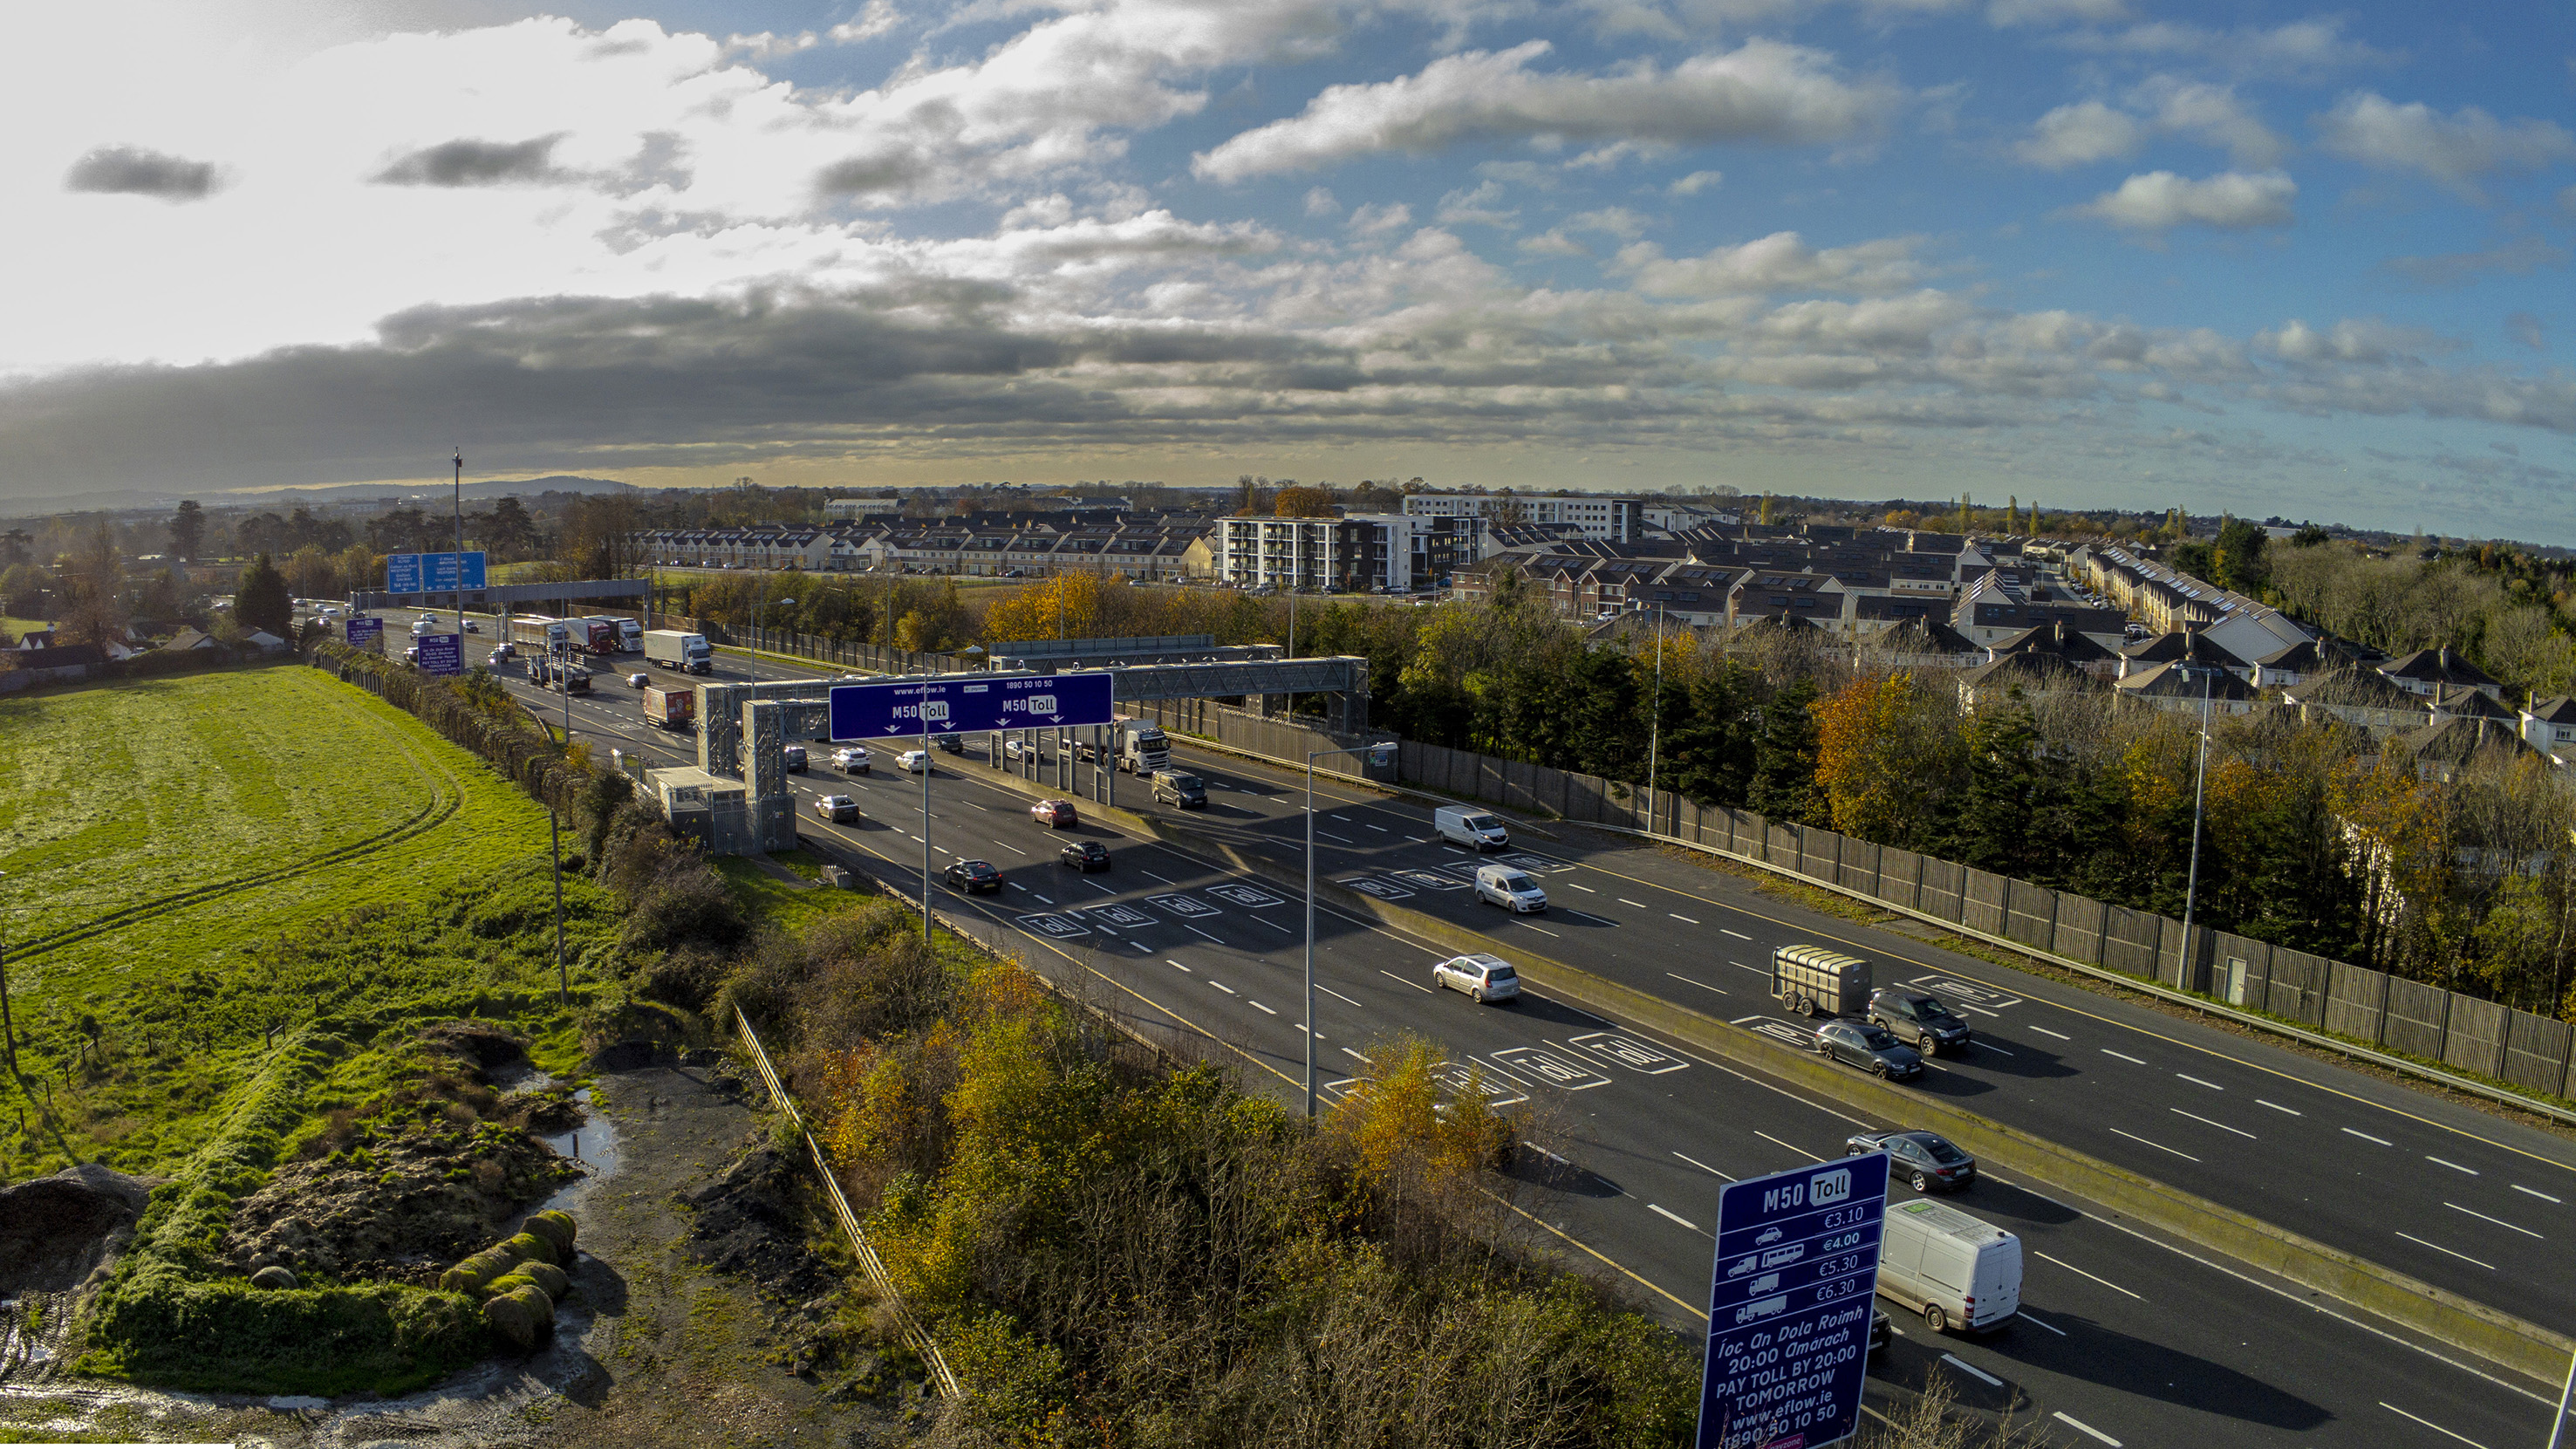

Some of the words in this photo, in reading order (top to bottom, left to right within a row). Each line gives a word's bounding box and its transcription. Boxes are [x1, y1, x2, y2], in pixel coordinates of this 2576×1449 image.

[894, 686, 946, 695] www.efow.ie
[893, 706, 917, 719] M50
[1003, 700, 1026, 712] M50
[1031, 700, 1054, 710] Toll
[1349, 881, 1399, 895] Toll
[1406, 873, 1456, 886] Toll
[1158, 896, 1207, 912] Toll
[1220, 886, 1270, 903] Toll
[1028, 915, 1076, 933] Toll
[1096, 906, 1145, 922] Toll
[1930, 981, 1999, 1001] Toll
[1590, 1040, 1666, 1066] Toll
[1513, 1055, 1589, 1081] Toll
[1764, 1184, 1803, 1213] M50
[1814, 1175, 1846, 1199] Toll
[1825, 1206, 1863, 1228] €3.10
[1823, 1232, 1860, 1251] €4.00
[1820, 1254, 1858, 1276] €5.30
[1817, 1279, 1855, 1301] €6.30
[1750, 1333, 1771, 1349] An
[1778, 1321, 1813, 1343] Dola
[1817, 1305, 1863, 1331] Roimh
[1728, 1348, 1779, 1375] 20:00
[1785, 1327, 1849, 1358] Amárach
[1717, 1377, 1746, 1398] PAY
[1751, 1366, 1787, 1388] TOLL
[1792, 1358, 1812, 1377] BY
[1814, 1345, 1856, 1370] 20:00
[1736, 1369, 1835, 1411] TOMORROW
[1732, 1390, 1833, 1431] www.eflow.ie
[1724, 1427, 1763, 1449] 1890
[1768, 1419, 1788, 1438] 50
[1794, 1411, 1812, 1429] 10
[1816, 1404, 1836, 1422] 50
